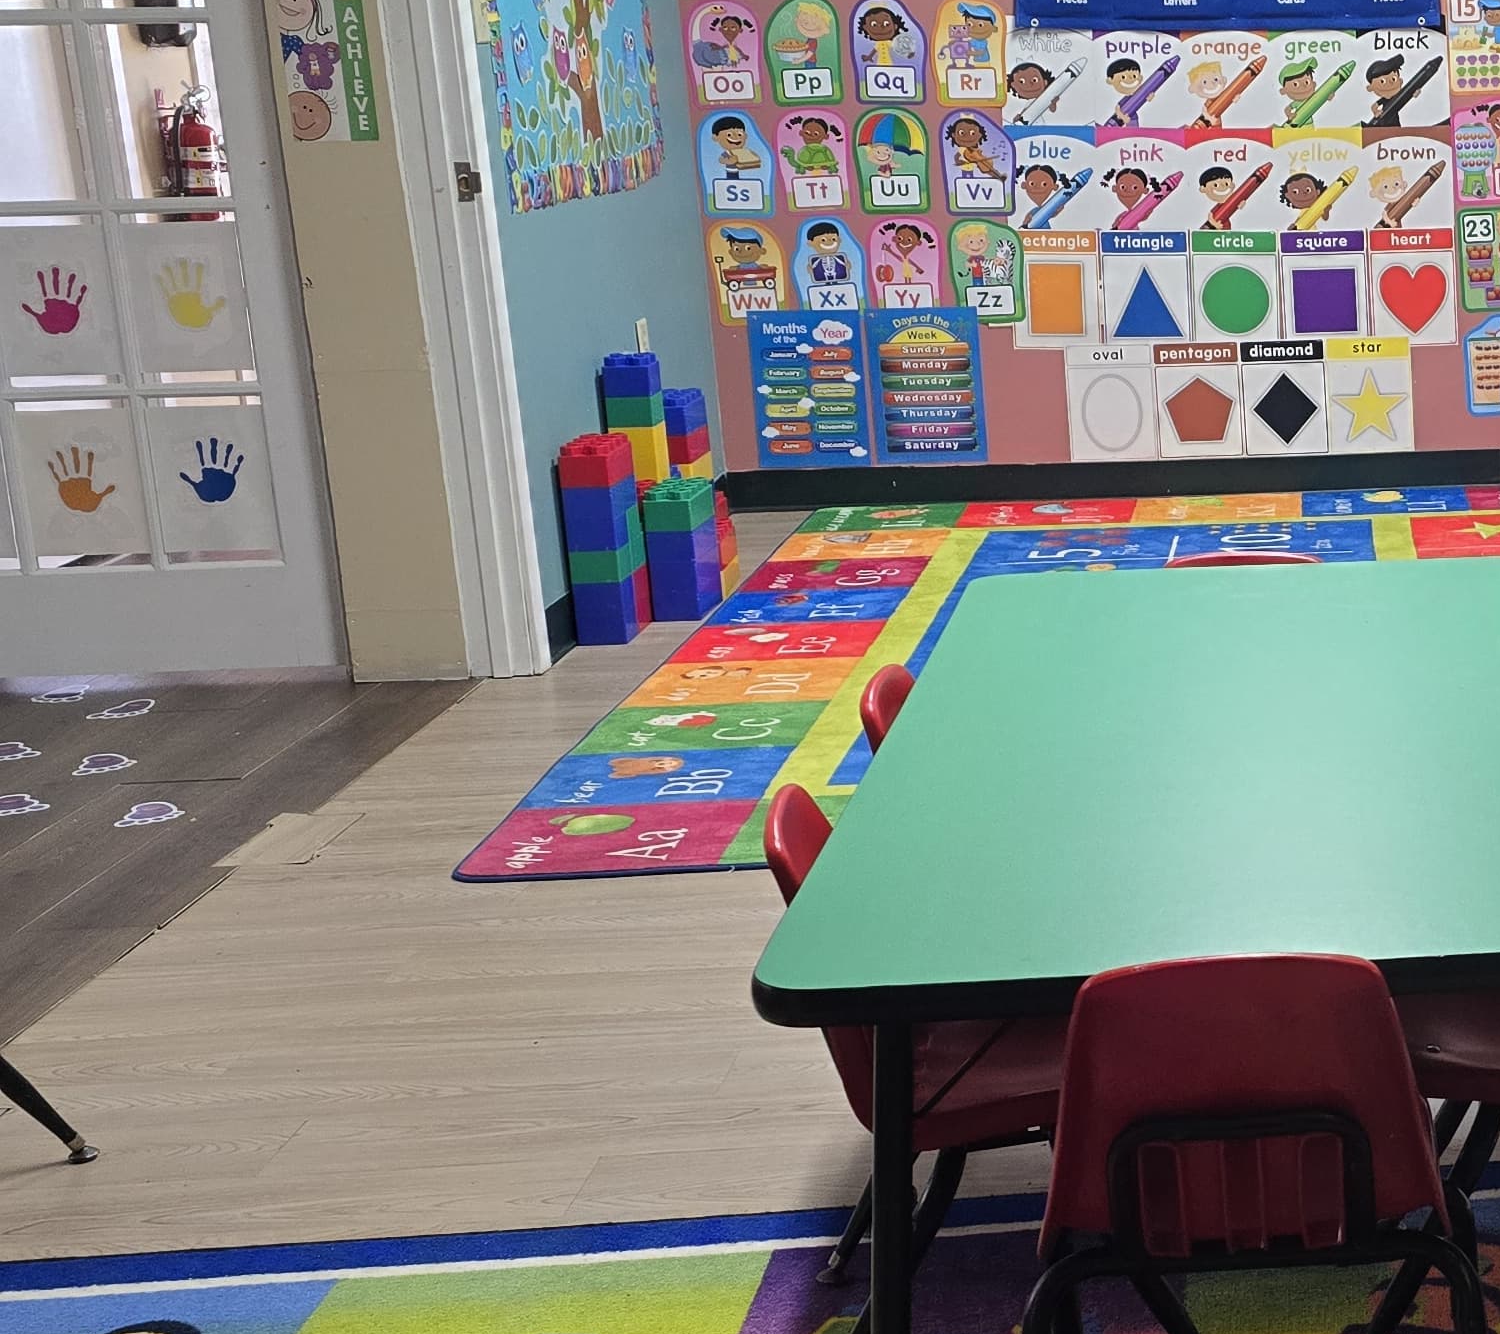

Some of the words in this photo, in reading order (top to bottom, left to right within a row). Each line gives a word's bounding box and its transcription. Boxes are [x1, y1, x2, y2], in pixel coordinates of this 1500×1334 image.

[1018, 36, 1072, 53] white
[1106, 39, 1172, 58] purple
[1285, 38, 1342, 58] green
[1374, 31, 1429, 50] black
[1192, 41, 1261, 58] orange
[343, 7, 371, 131] ACHIEVE
[714, 76, 744, 94] Oo
[795, 74, 821, 95] Pp
[874, 73, 908, 94] Qq
[961, 74, 982, 91] Rr
[1029, 141, 1071, 161] blue
[1120, 144, 1163, 165] pink
[1213, 144, 1247, 162] red
[1289, 144, 1347, 165] yellow
[1378, 143, 1436, 161] brown
[726, 184, 750, 202] Ss
[807, 183, 829, 199] Tt
[880, 179, 909, 197] Uu
[966, 183, 992, 201] Vv
[1466, 220, 1491, 237] 23
[1023, 234, 1090, 250] ectangle
[1113, 234, 1174, 251] triangle
[1213, 234, 1254, 249] circle
[1296, 236, 1348, 251] square
[1391, 232, 1431, 245] heart
[732, 294, 771, 310] Ww
[820, 290, 846, 307] Xx
[895, 290, 920, 308] Yy
[977, 293, 1002, 308] Zz
[763, 323, 807, 334] Months
[893, 316, 918, 328] Days
[920, 314, 931, 324] of
[934, 315, 949, 328] the
[773, 335, 782, 343] of
[821, 329, 848, 338] Year
[908, 331, 938, 339] Week
[1093, 348, 1123, 362] oval
[1160, 346, 1231, 362] pentagon
[1249, 342, 1313, 358] diamond
[1352, 341, 1382, 353] star
[894, 394, 962, 402] Wednesday
[905, 441, 958, 449] Saturday
[835, 569, 900, 586] Gg
[776, 635, 838, 656] Ee
[744, 672, 812, 695] Dd
[712, 718, 781, 740] Cc
[655, 769, 733, 797] Bb
[554, 781, 604, 804] bear
[506, 836, 554, 869] apple
[605, 828, 688, 860] Aa
